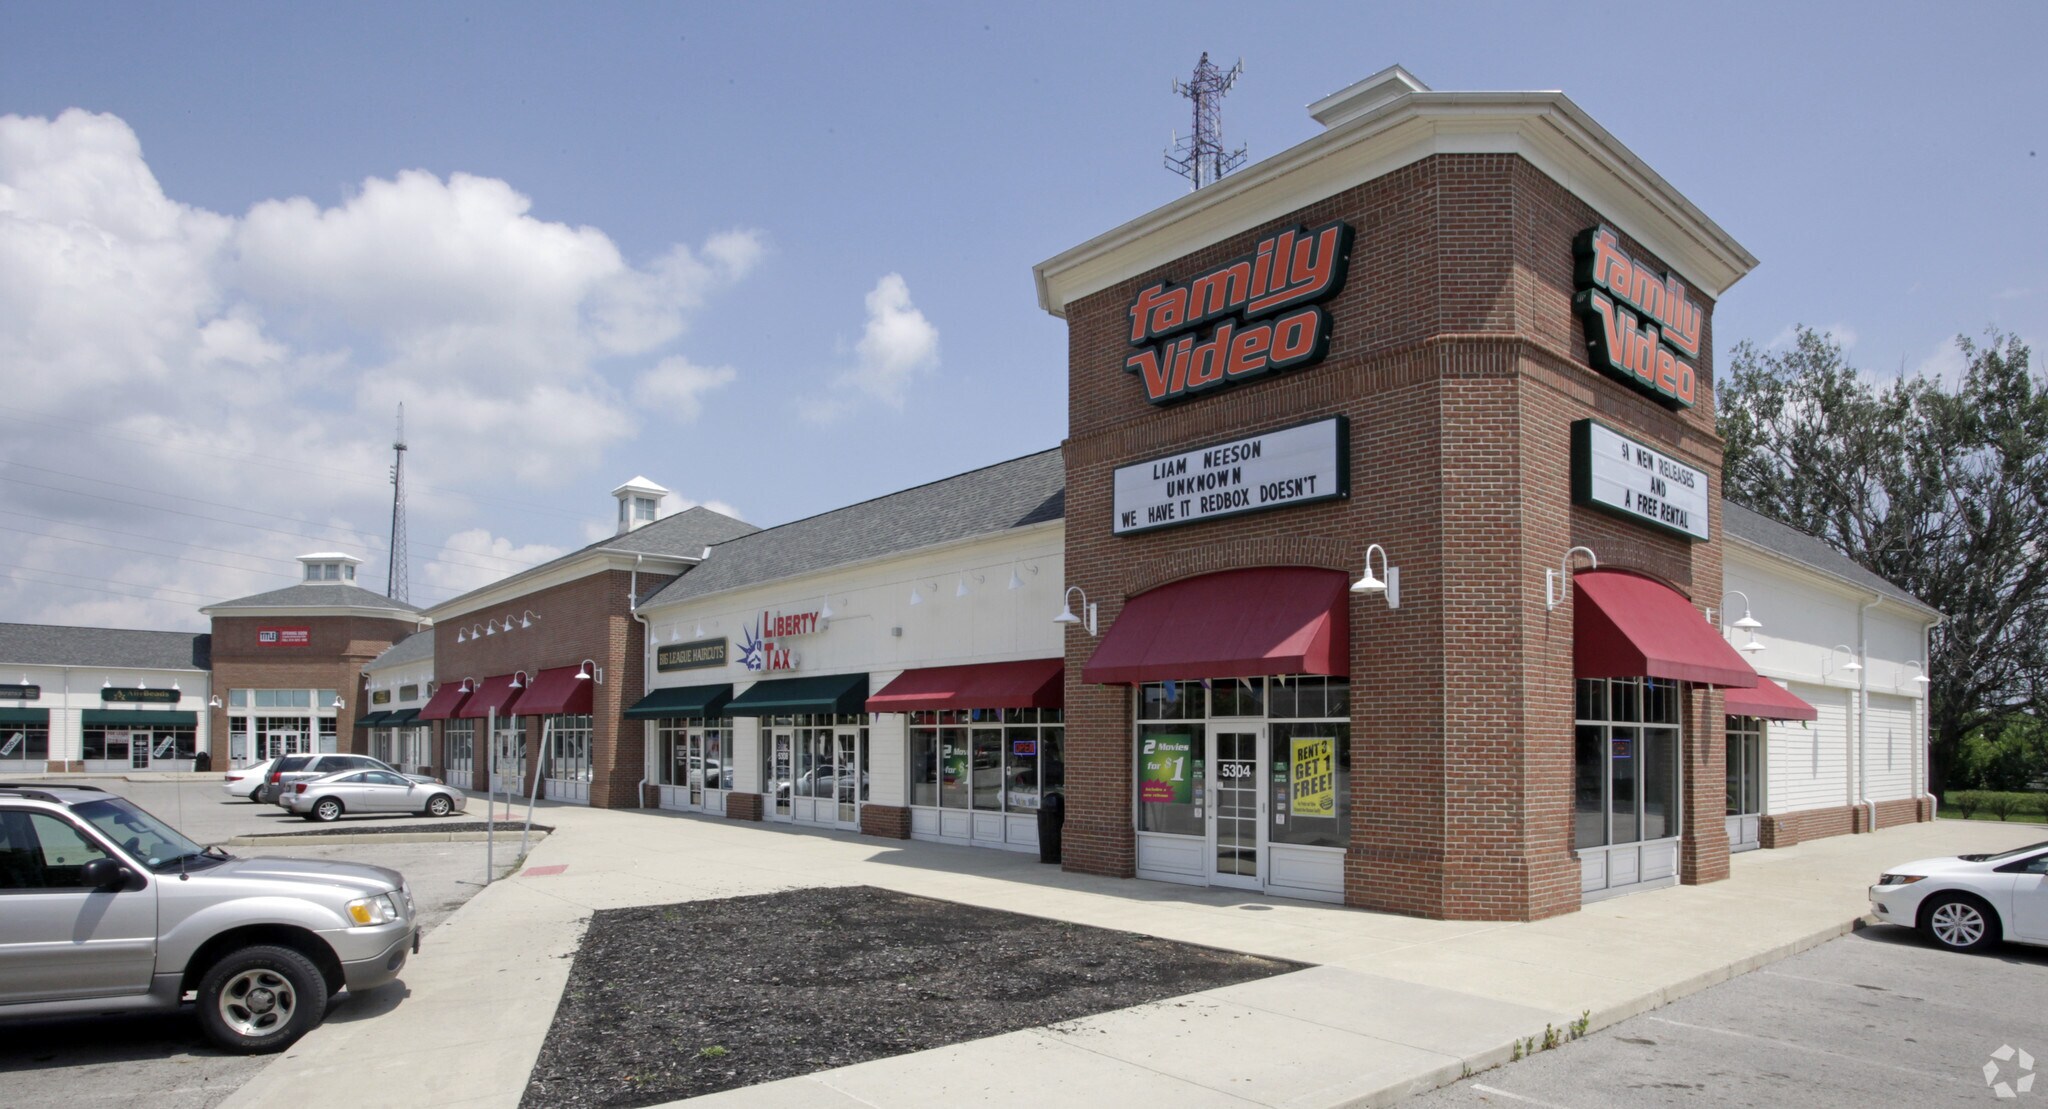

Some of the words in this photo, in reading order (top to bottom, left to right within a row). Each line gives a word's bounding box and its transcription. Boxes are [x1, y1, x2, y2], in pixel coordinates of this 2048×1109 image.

[1130, 226, 1338, 341] family
[1594, 229, 1701, 355] family
[1126, 310, 1318, 399] Video
[1593, 295, 1695, 404] Video
[1153, 457, 1187, 480] LIAM
[1204, 440, 1261, 469] NEESON
[1637, 448, 1653, 471] NEW
[1658, 458, 1695, 488] RELEASES
[1167, 467, 1241, 498] UNKNOWN
[1651, 477, 1666, 498] AND
[1121, 510, 1137, 528] WE
[1148, 503, 1175, 523] HAVE
[1180, 499, 1191, 517] IT
[1201, 488, 1249, 514] REDBOX
[1260, 475, 1316, 503] DOESN'T
[1625, 489, 1631, 508] A
[1637, 494, 1657, 518] FREE
[1661, 502, 1688, 529] RENTAL
[763, 611, 819, 638] LIBERTY
[669, 650, 692, 665] LEAGUE
[693, 645, 724, 661] HAIRCUTS
[764, 643, 791, 670] TAX
[943, 745, 952, 758] 2
[1015, 742, 1035, 752] OPEN
[1143, 739, 1156, 754] 2
[1158, 743, 1189, 751] Movies
[1298, 742, 1320, 761] RENT
[1321, 740, 1327, 754] 3
[1147, 761, 1161, 770] for
[1222, 764, 1251, 777] 5304
[1296, 758, 1320, 780] GET
[1323, 754, 1330, 771] 1
[1294, 772, 1333, 800] FREE!
